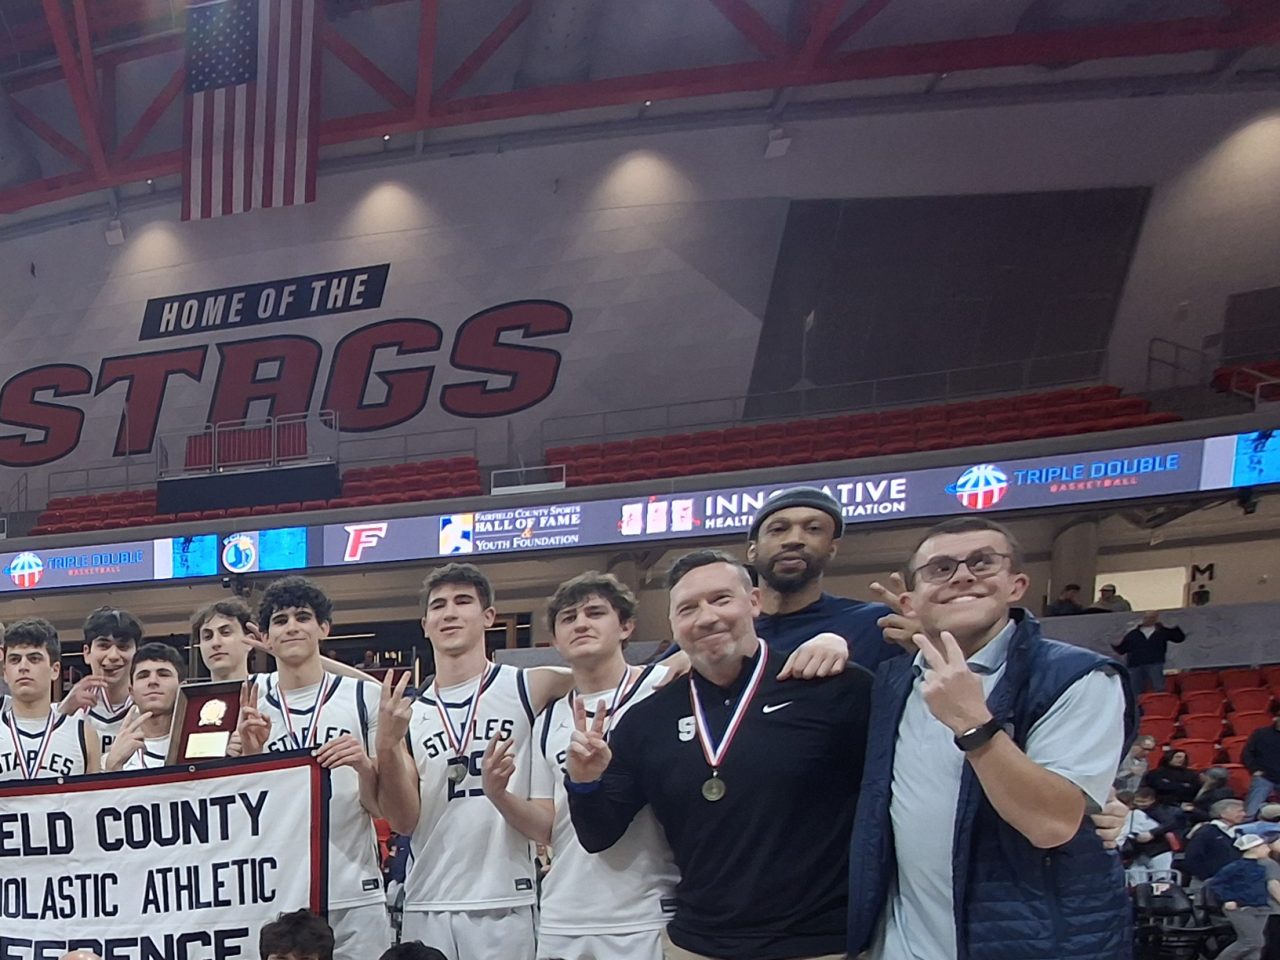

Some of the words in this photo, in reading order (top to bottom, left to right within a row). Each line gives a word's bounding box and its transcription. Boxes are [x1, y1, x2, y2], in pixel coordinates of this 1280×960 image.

[159, 292, 247, 333] HOME
[257, 284, 297, 319] OF
[309, 273, 369, 312] THE
[1013, 462, 1084, 486] TRIPLE
[1090, 453, 1181, 479] DOUBLE
[1049, 477, 1138, 493] BASKETBALL
[475, 512, 514, 522] FAIRFIELD
[515, 508, 549, 519] COUNTY
[550, 505, 581, 515] SPORTS
[705, 478, 907, 517] INNTIVE
[475, 519, 513, 532] HALL
[515, 518, 536, 531] OF
[539, 514, 581, 528] FAME
[343, 522, 389, 562] F
[475, 540, 510, 551] YOUTH
[513, 534, 579, 549] FOUNDATION
[47, 554, 89, 570] TRIPLE
[92, 550, 144, 567] DOUBLE
[1191, 563, 1215, 581] M
[422, 719, 514, 759] STLES
[95, 789, 269, 852] COUNTY
[141, 856, 277, 914] ATHLETIC
